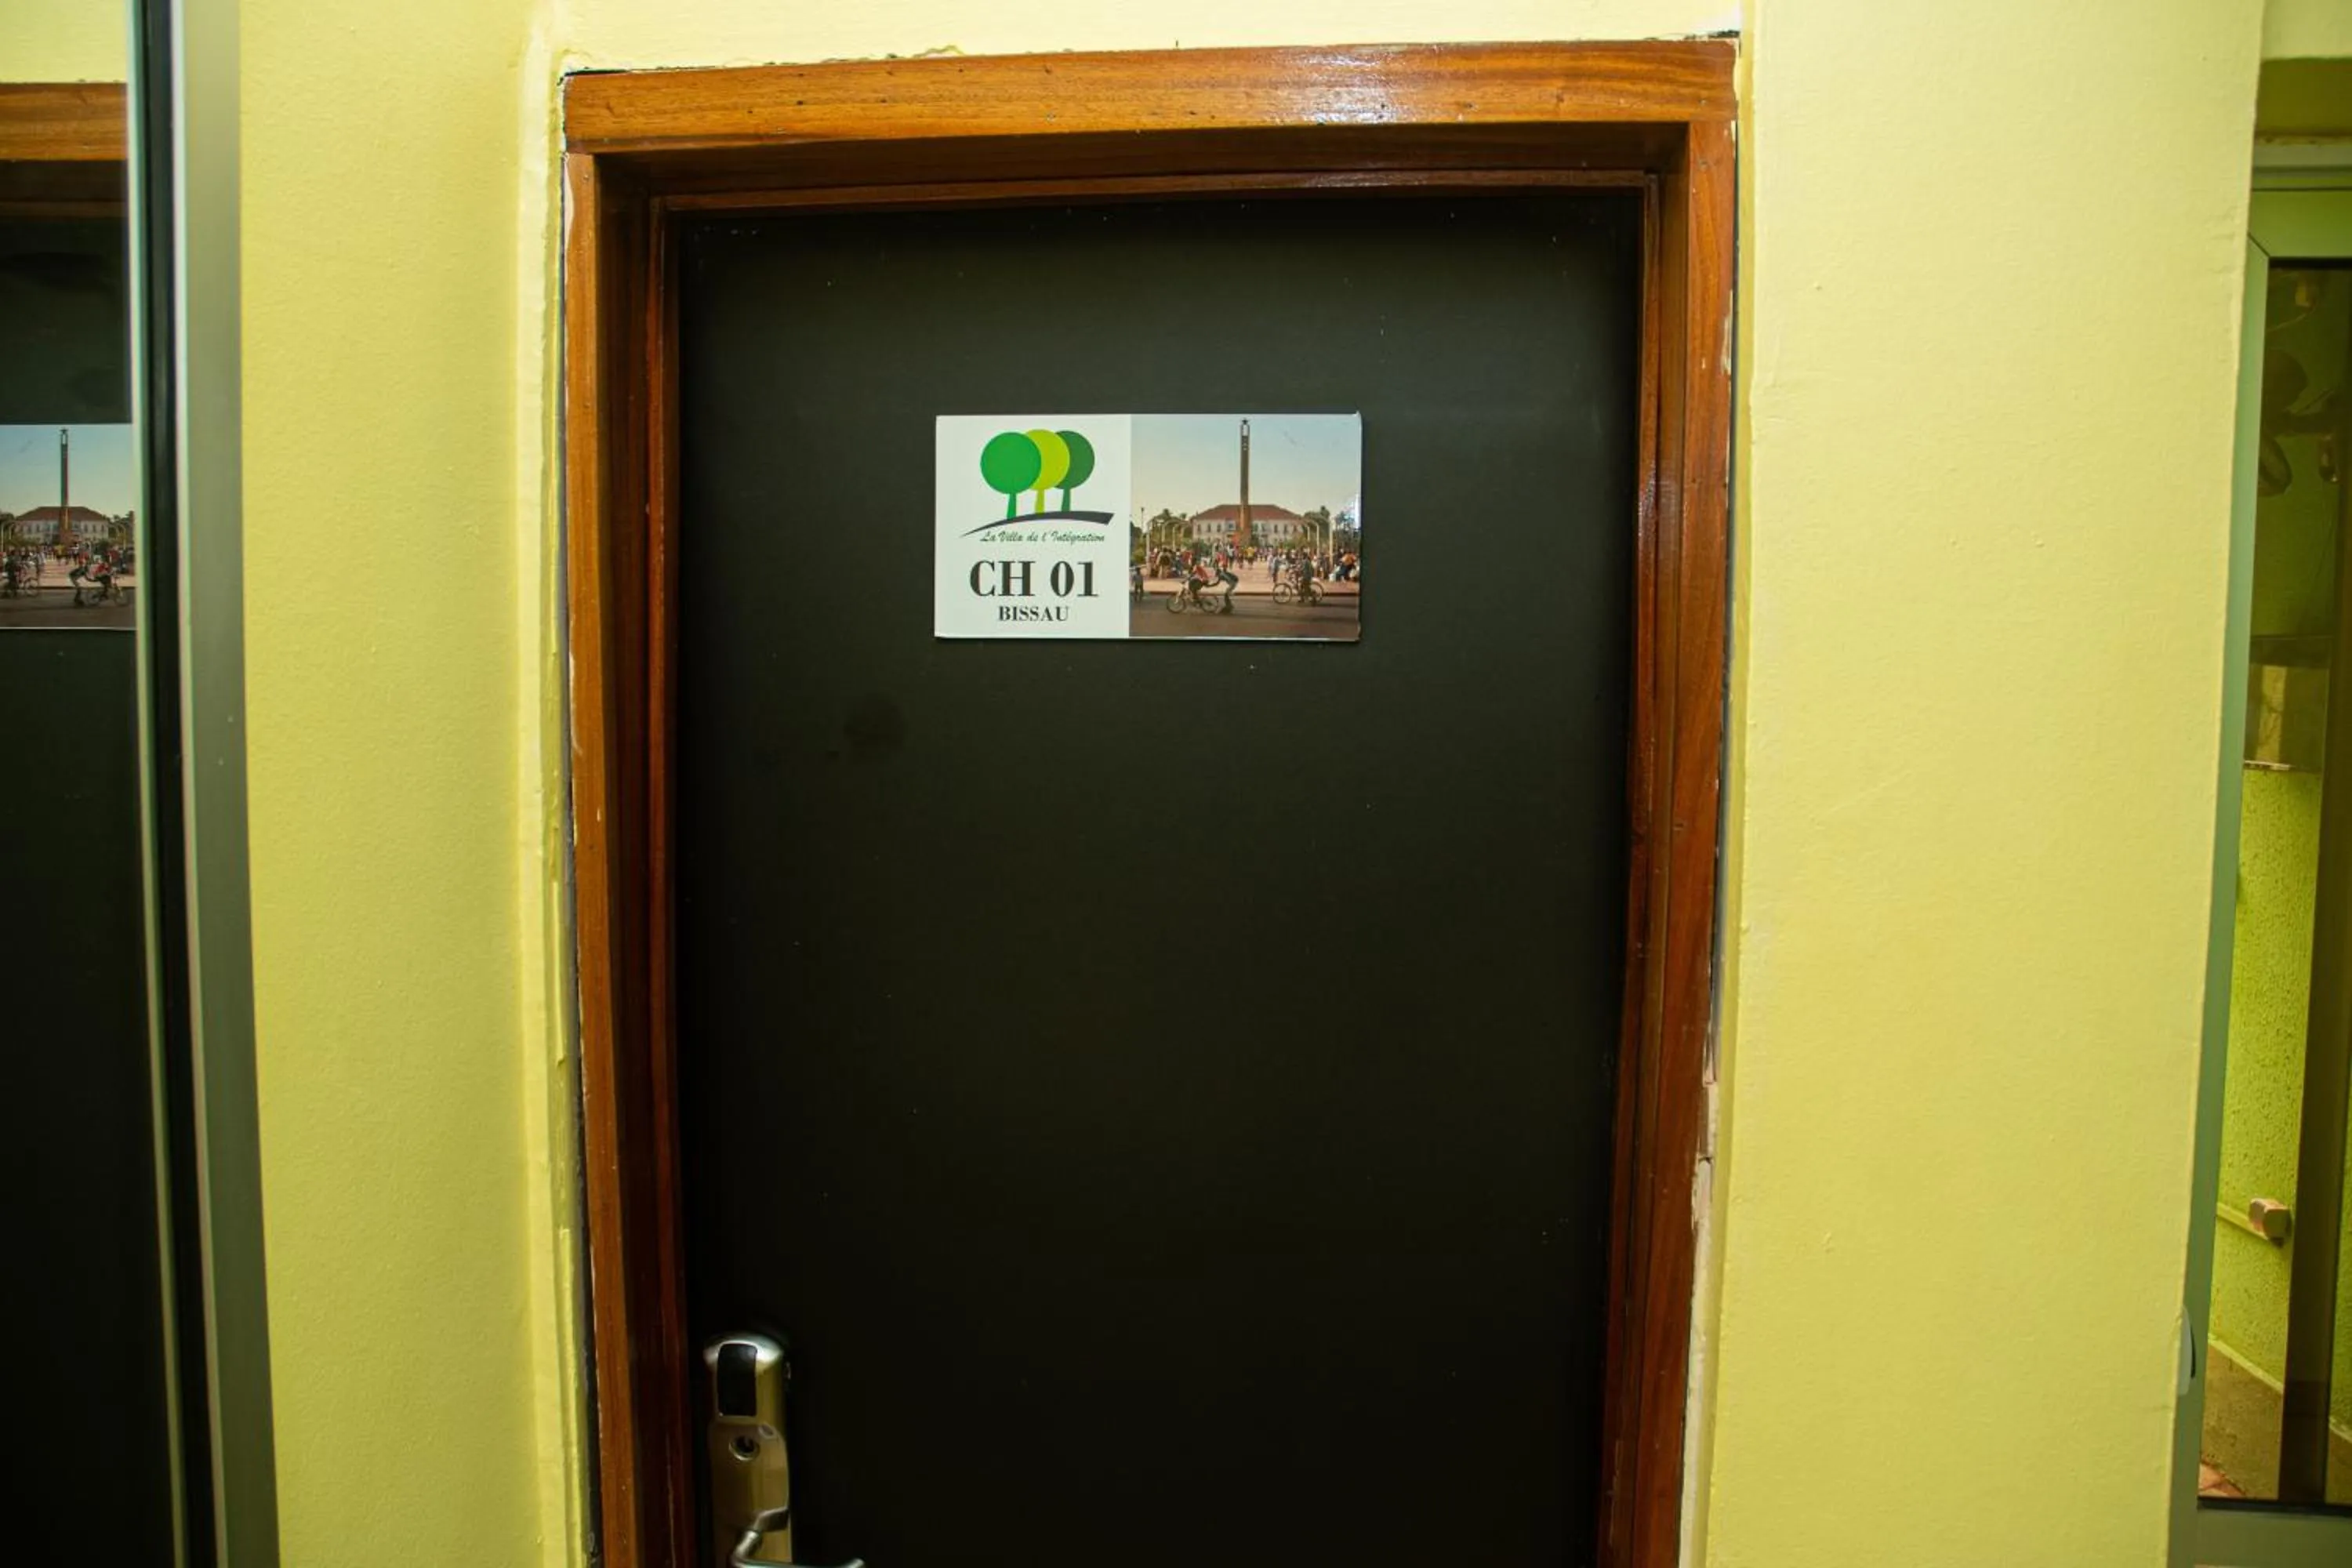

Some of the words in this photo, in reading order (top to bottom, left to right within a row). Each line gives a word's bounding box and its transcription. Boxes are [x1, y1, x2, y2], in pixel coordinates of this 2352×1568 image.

[981, 531, 996, 542] La
[1026, 532, 1039, 542] de
[970, 560, 1036, 597] CH
[1050, 560, 1099, 597] 01
[998, 606, 1069, 622] BISSAU
